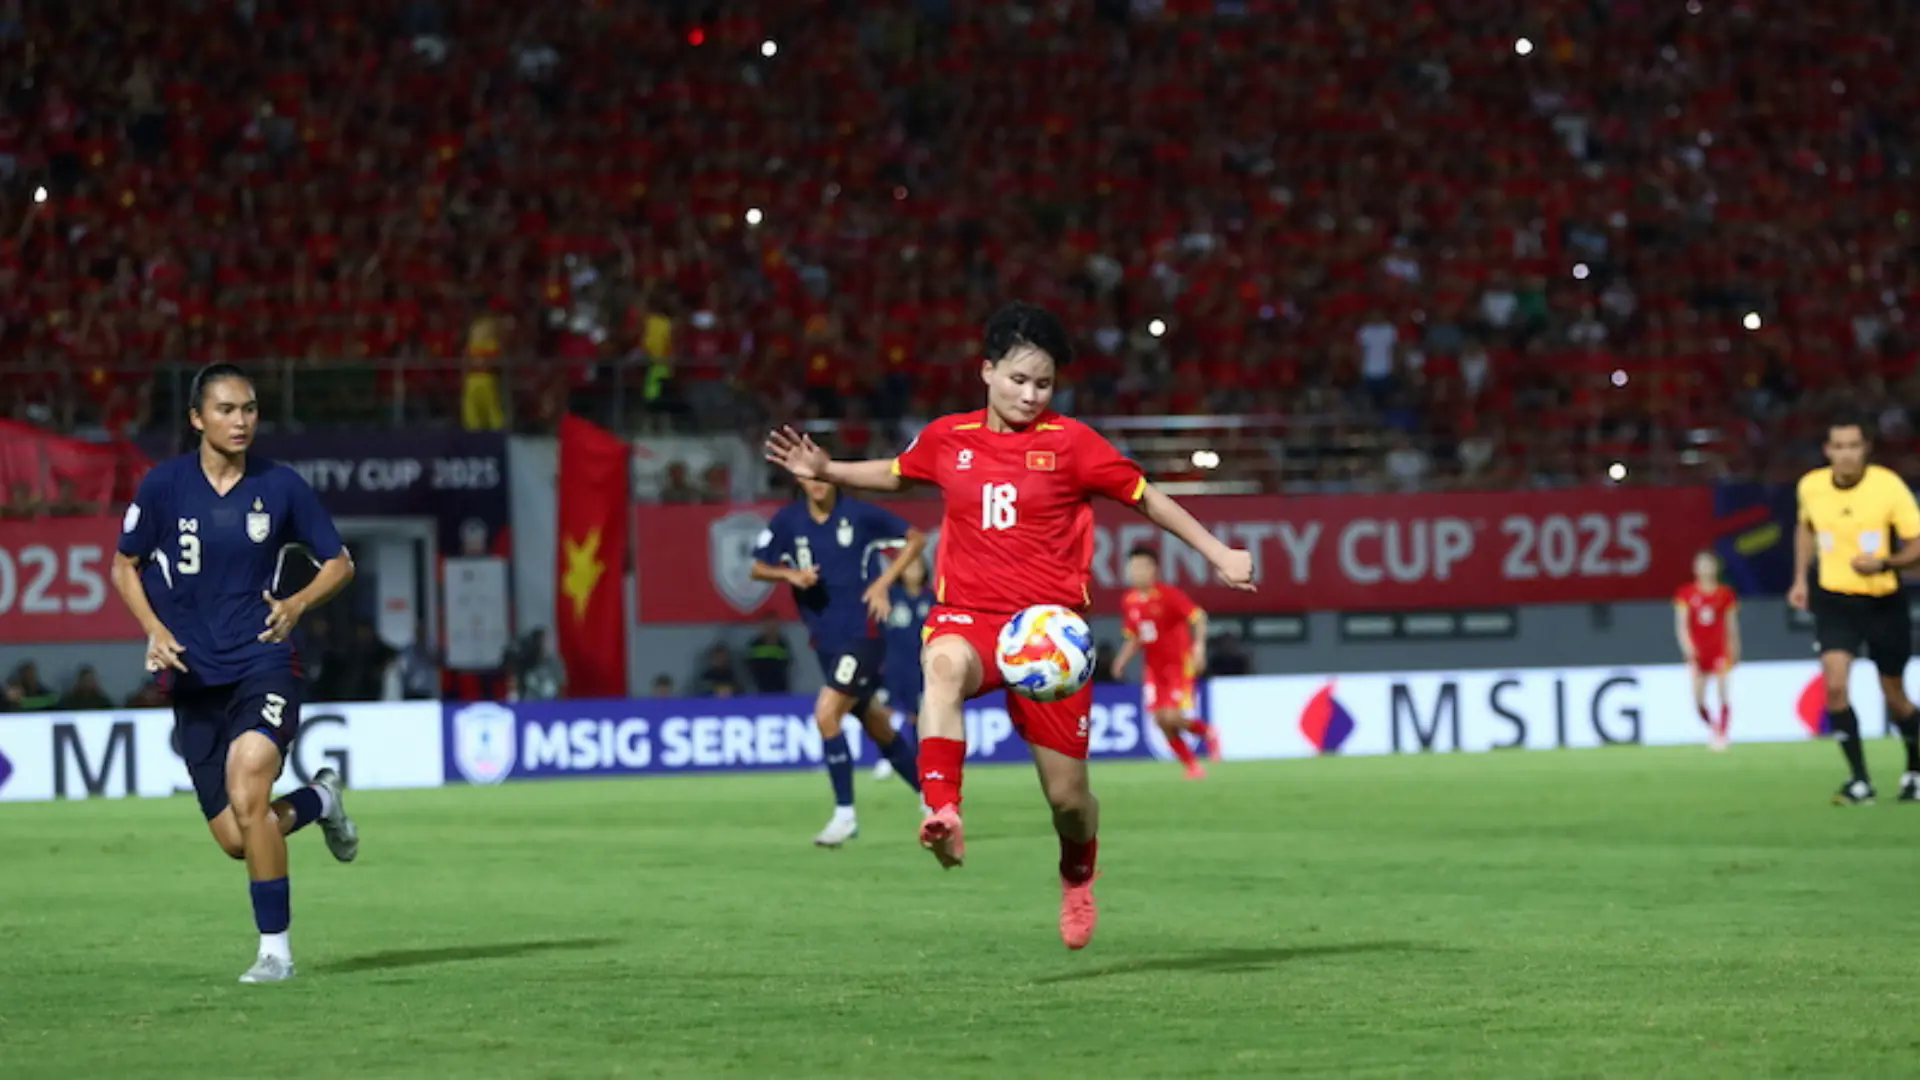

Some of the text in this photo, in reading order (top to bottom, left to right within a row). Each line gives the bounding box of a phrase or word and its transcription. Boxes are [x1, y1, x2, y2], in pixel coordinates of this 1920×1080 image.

[358, 458, 422, 491] CUP
[432, 457, 500, 489] 2025
[982, 482, 1018, 530] 18
[177, 534, 200, 574] 3
[1338, 517, 1475, 583] CUP
[1502, 511, 1651, 579] 2025
[0, 546, 106, 616] 25
[834, 654, 858, 685] 8
[524, 718, 650, 769] MSIG
[659, 713, 901, 767] SEREN
[1089, 703, 1140, 752] 25
[1390, 676, 1641, 754] MSIG
[53, 714, 350, 798] MG
